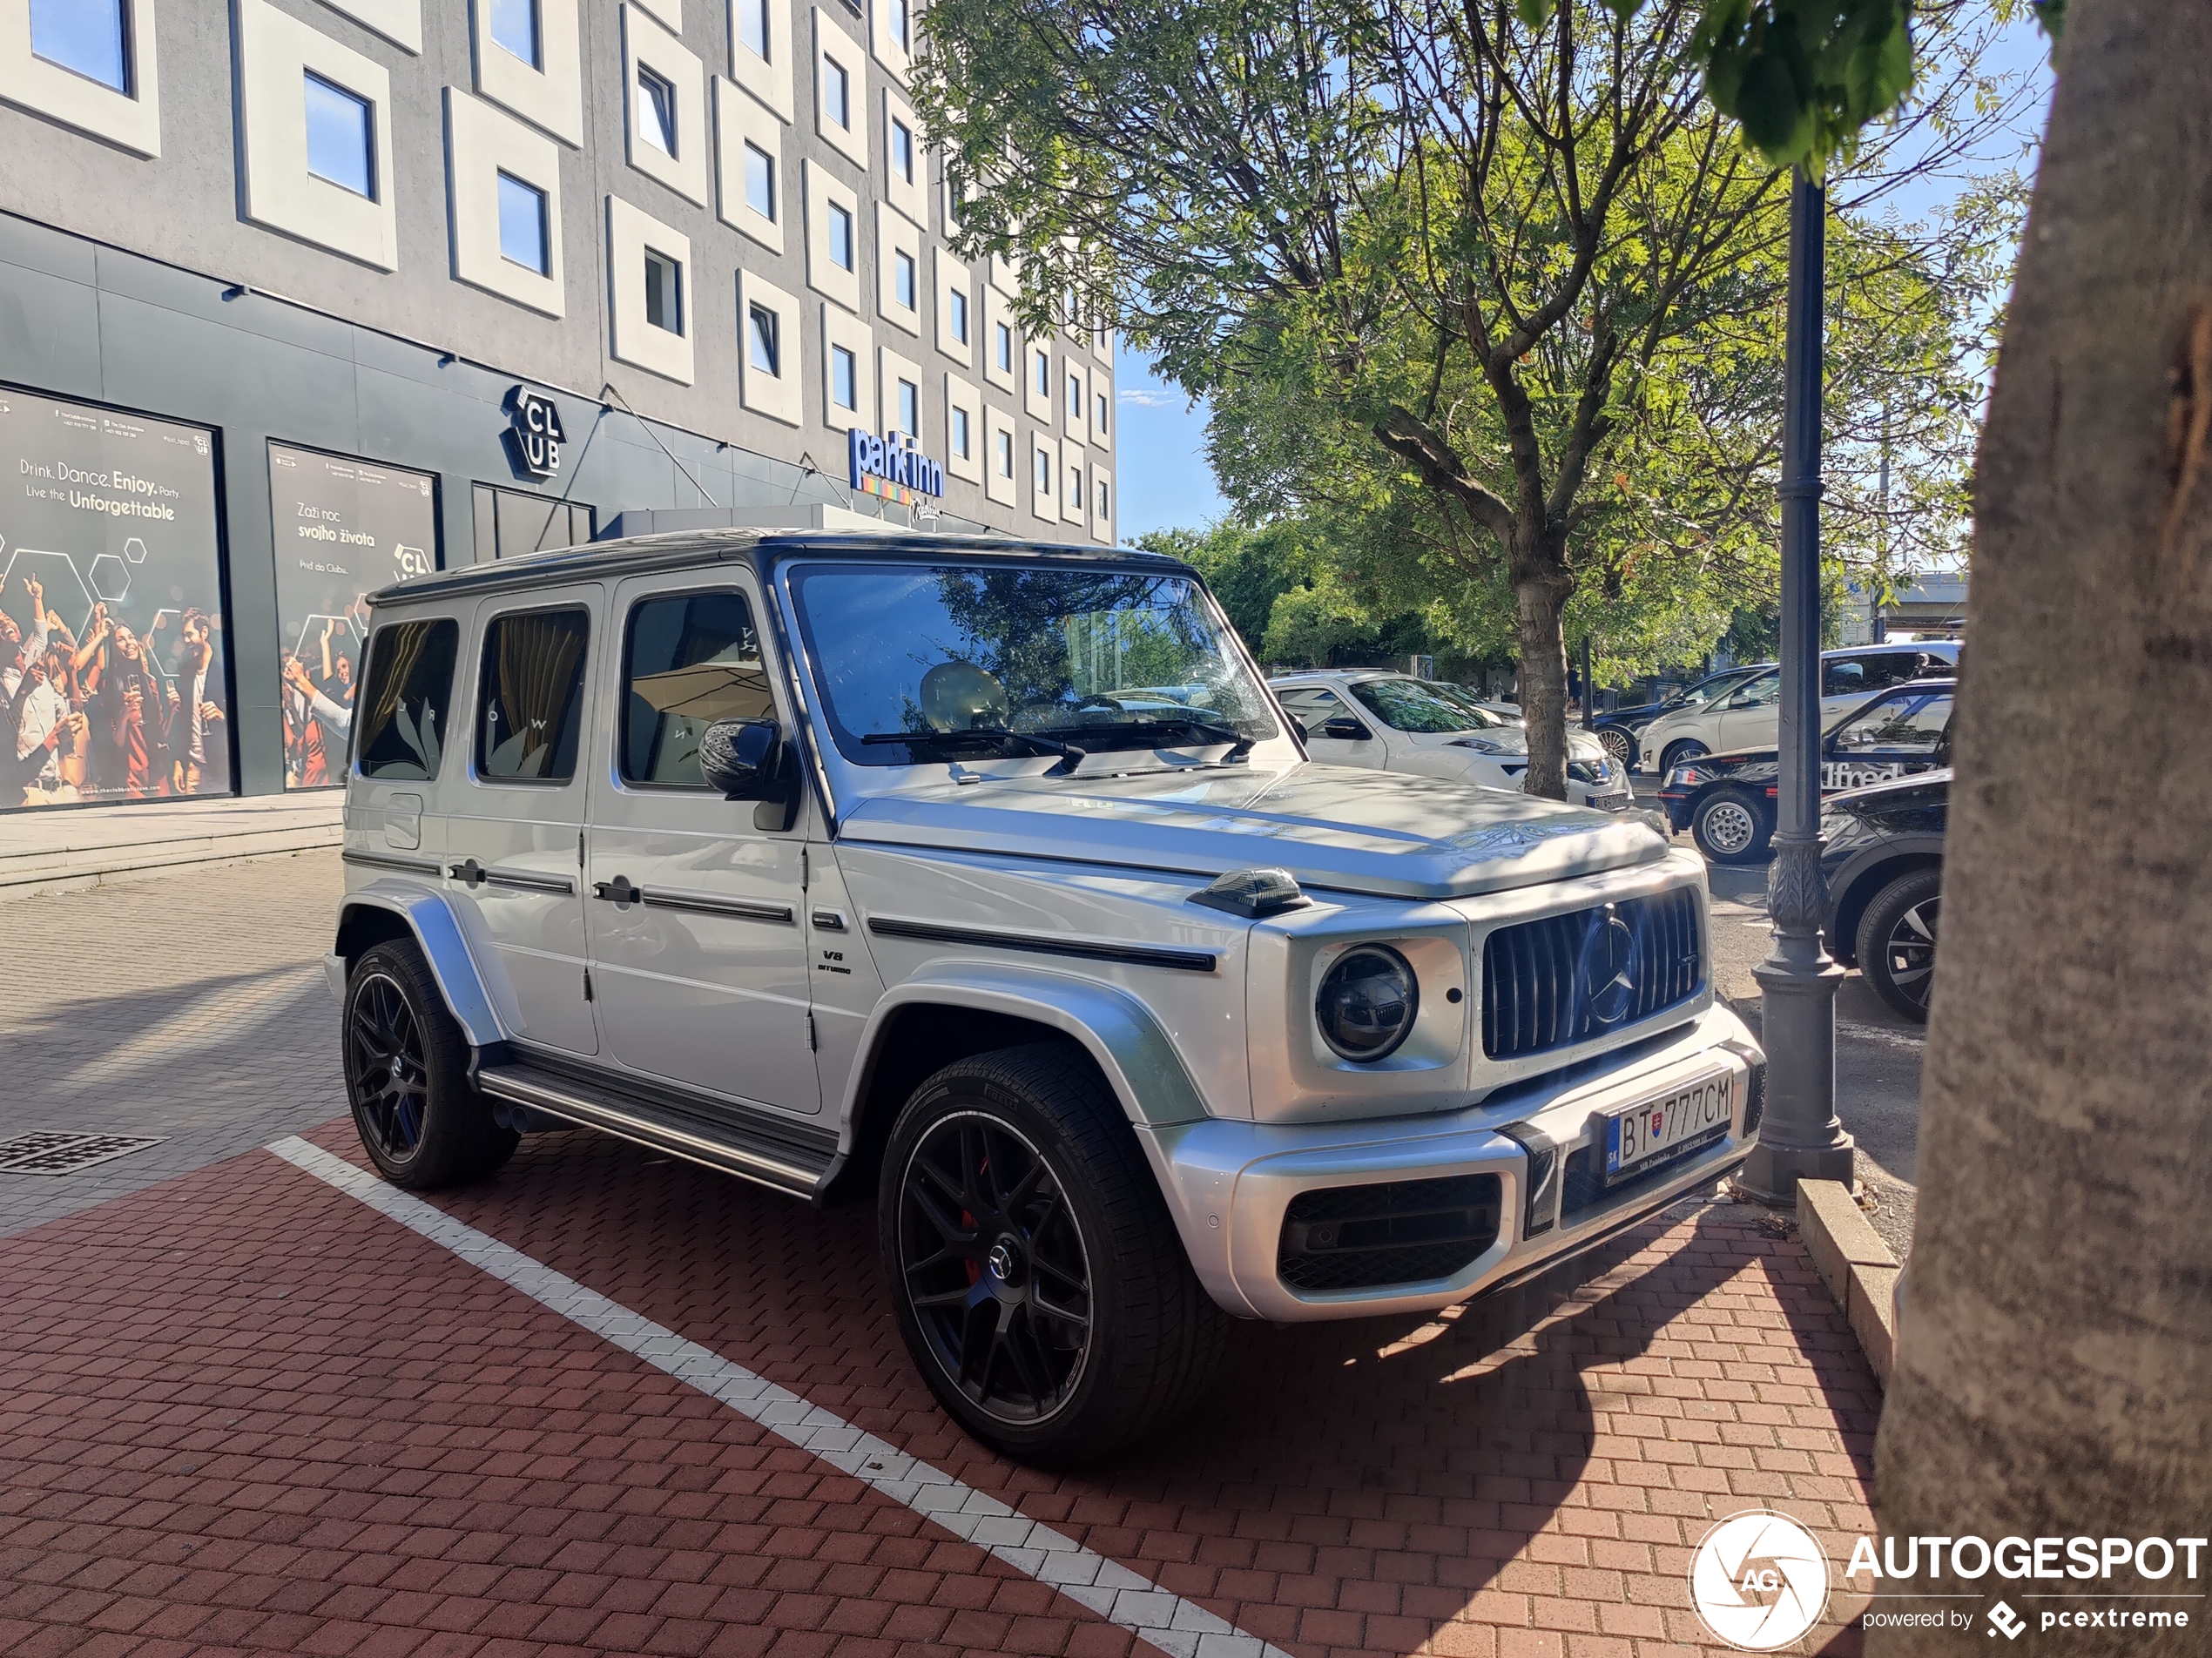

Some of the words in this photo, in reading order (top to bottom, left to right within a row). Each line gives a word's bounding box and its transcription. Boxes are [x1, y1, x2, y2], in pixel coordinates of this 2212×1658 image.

[849, 428, 910, 489] park
[907, 438, 943, 497] inn
[20, 459, 55, 479] Drink.
[57, 462, 111, 488] Dance.
[113, 470, 158, 496] Enjoy.
[159, 486, 181, 499] Party.
[26, 484, 46, 499] Live
[50, 489, 65, 501] the
[70, 489, 175, 521] Unforgettable
[297, 502, 320, 519] Zaži
[322, 510, 341, 522] noc
[298, 524, 337, 542] svojho
[340, 529, 375, 547] života
[315, 563, 325, 572] do
[1822, 762, 1898, 789] lfred
[823, 950, 843, 961] V8
[818, 964, 851, 974] BITURBO
[1622, 1109, 1651, 1162] BT
[1665, 1077, 1730, 1142] 777CM
[1608, 1150, 1618, 1164] SK
